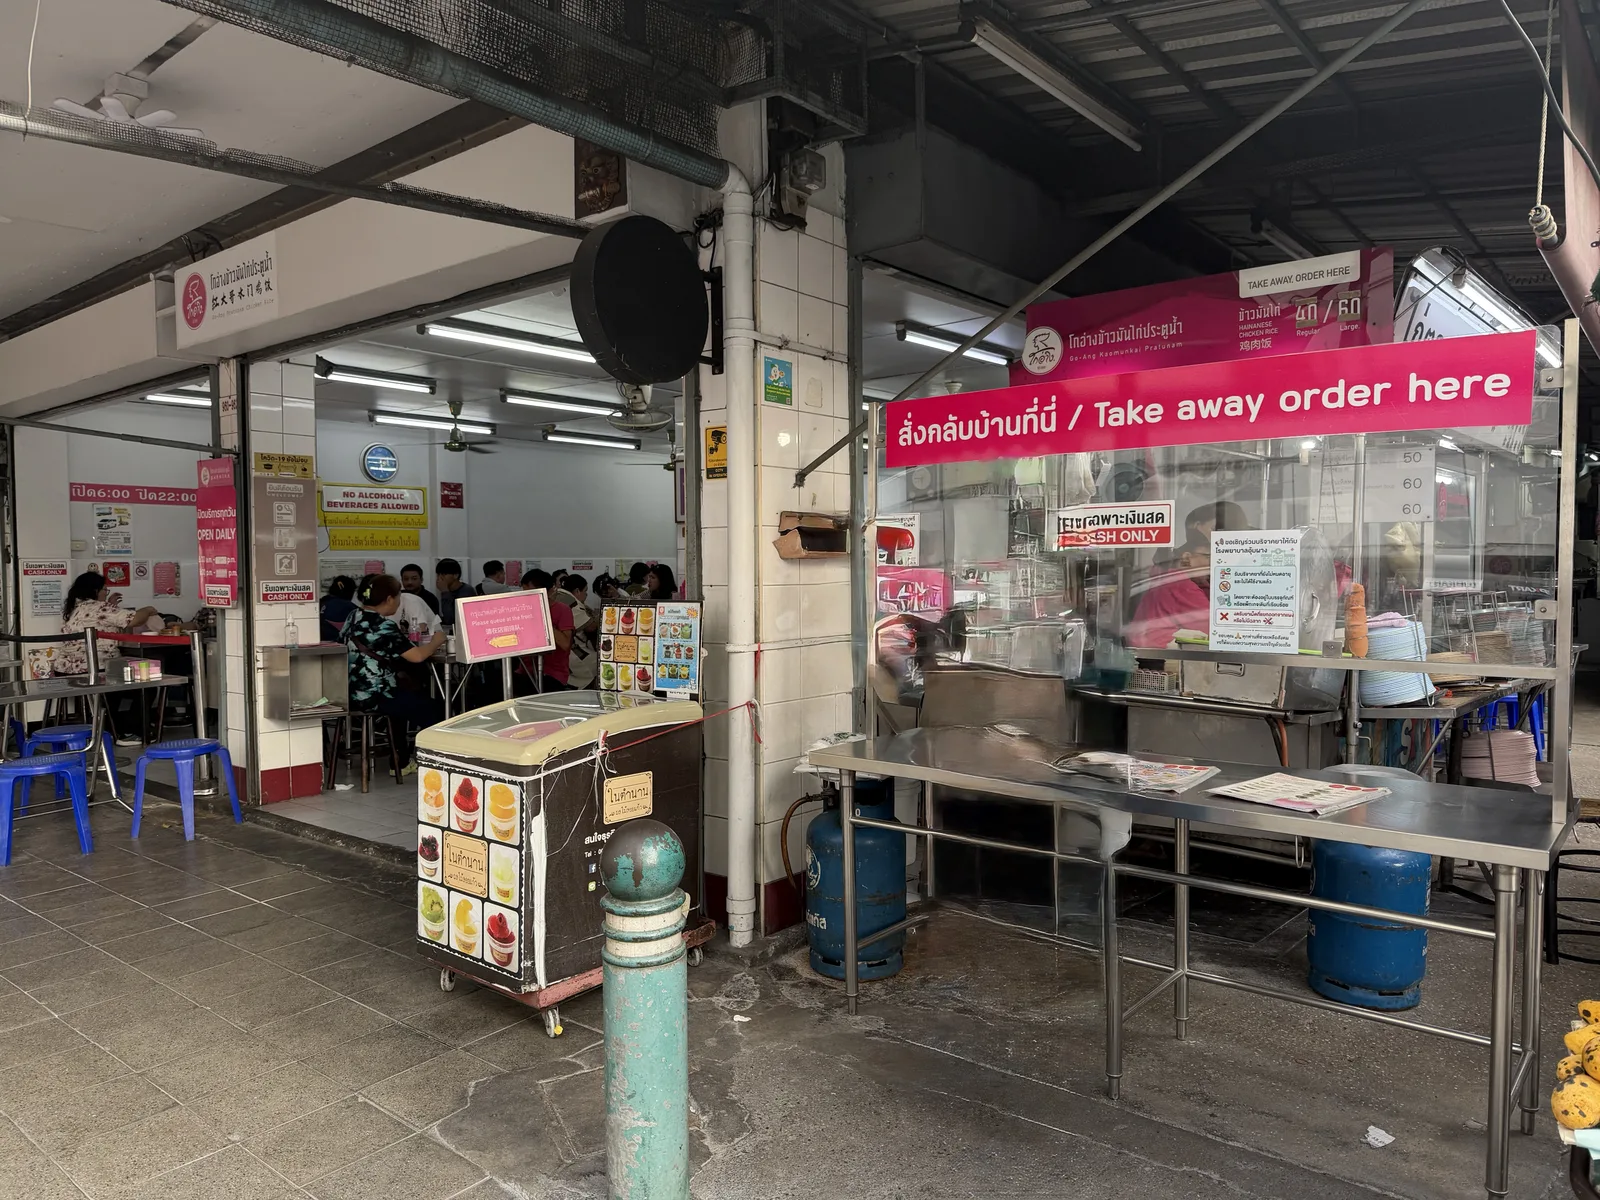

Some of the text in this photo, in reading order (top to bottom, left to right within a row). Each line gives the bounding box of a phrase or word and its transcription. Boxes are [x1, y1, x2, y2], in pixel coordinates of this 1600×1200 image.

[1248, 279, 1269, 290] TAKE
[1295, 270, 1325, 282] ORDER
[1326, 266, 1351, 277] HERE
[1238, 302, 1281, 322] ข้าวมันไก่
[1295, 303, 1318, 322] 40
[1338, 297, 1361, 316] 60
[1238, 321, 1273, 331] HAINANESE
[1068, 316, 1183, 350] โกอ่างข้าวมันไก่ประตูน้ำ
[1238, 327, 1279, 339] CHICKEN RICE
[1069, 341, 1183, 362] Go-Ang Kaomunkai Pratunam
[1239, 338, 1272, 352] 鸡肉饭
[898, 372, 1512, 448] สั่งกลับบ้านที่นี่ / Take away order here
[1403, 451, 1422, 464] 50
[1402, 478, 1423, 489] 60
[72, 485, 197, 503] เปิด6:00 ปิด22:00
[358, 492, 405, 500] ALCOHOLIC
[327, 501, 420, 511] BEVERAGES ALLOWED
[1402, 503, 1422, 515] 60
[197, 527, 237, 540] OPEN DAILY
[1119, 529, 1160, 543] ONLY
[264, 581, 311, 593] รับเฉพาะเงินสด
[289, 593, 309, 601] ONLY
[471, 619, 489, 627] Please
[607, 787, 649, 804] ในตำนาน
[447, 843, 484, 872] ในตำนาน
